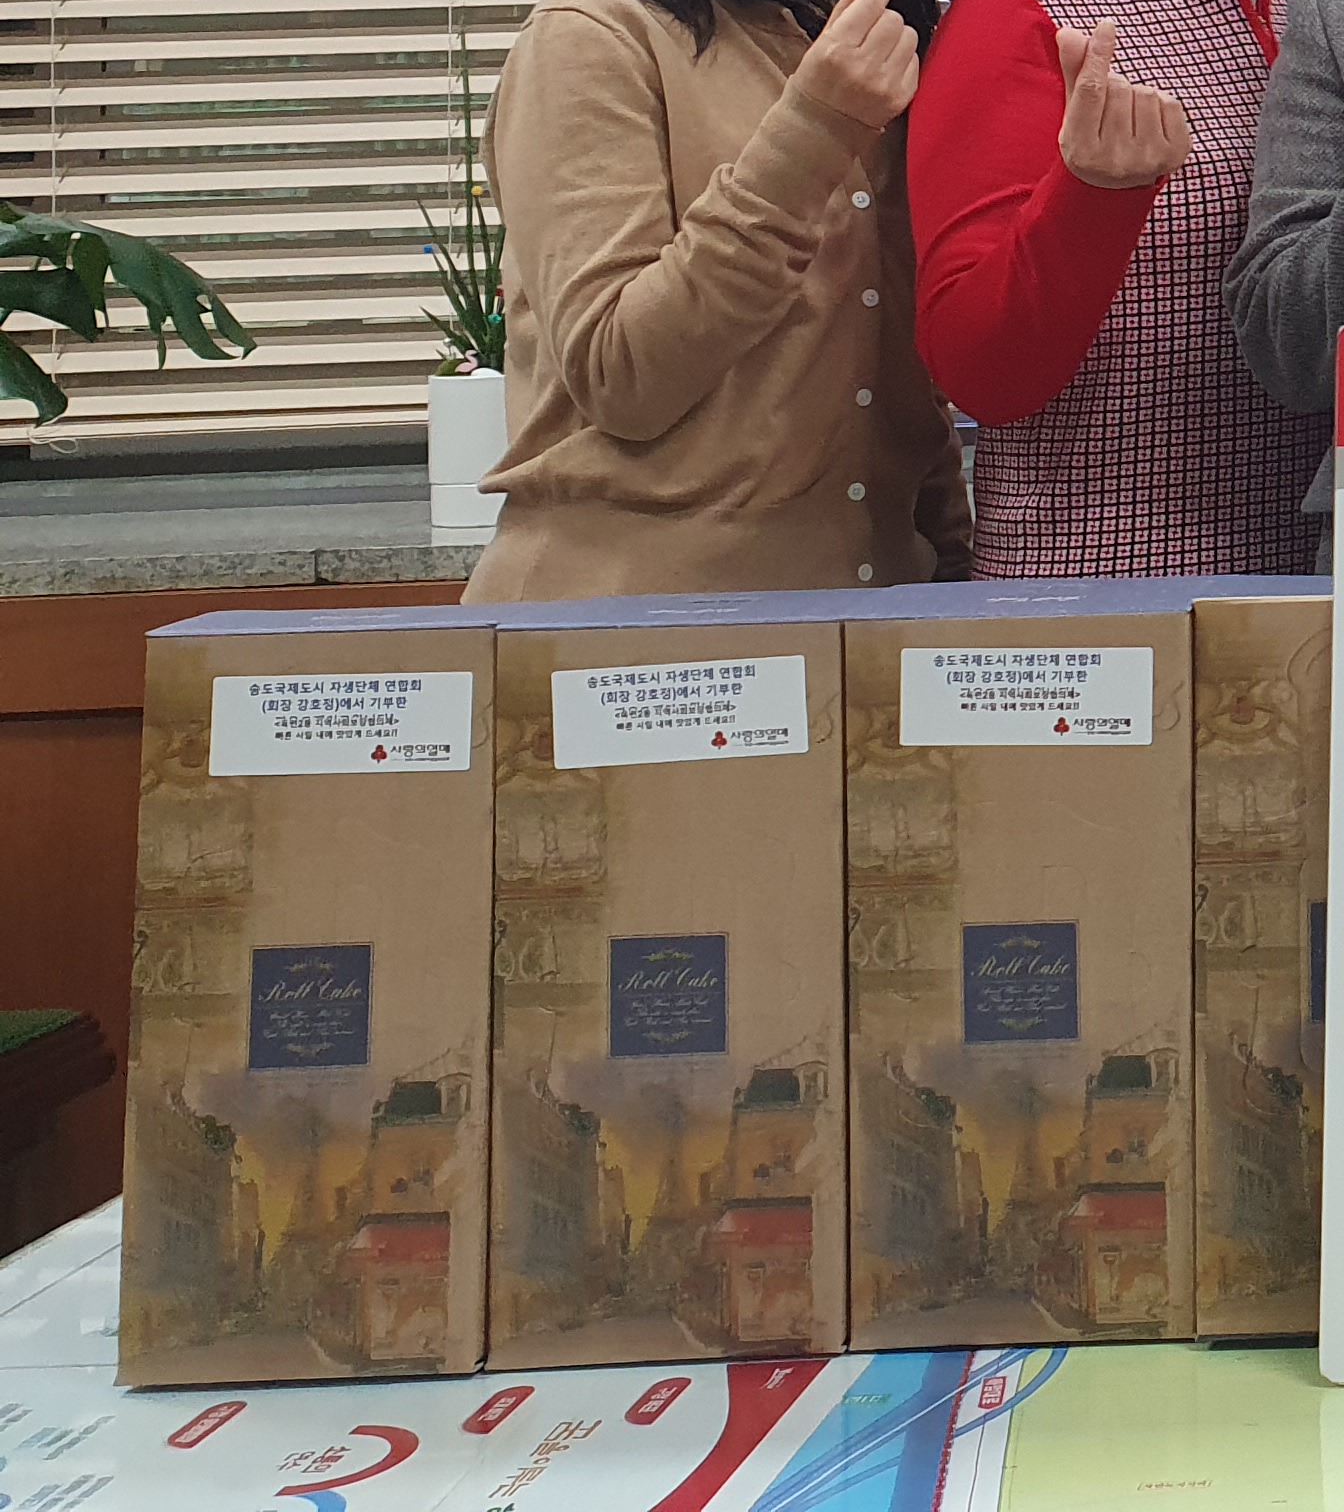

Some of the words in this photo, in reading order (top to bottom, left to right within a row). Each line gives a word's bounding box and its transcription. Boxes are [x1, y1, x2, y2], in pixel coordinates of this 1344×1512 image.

[934, 654, 1007, 667] 송도국제도시
[1012, 654, 1060, 666] 자생단체
[1065, 654, 1101, 666] 연합회
[588, 673, 660, 688] 송도국제도시
[665, 667, 713, 681] 자생단체
[719, 665, 756, 678] 연합회
[1051, 671, 1087, 682] 기부한
[249, 682, 324, 695] 송도국제도시
[330, 681, 380, 693] 자생단체
[385, 680, 422, 692] 연합회
[706, 683, 742, 696] 기부한
[370, 697, 407, 709] 기부한
